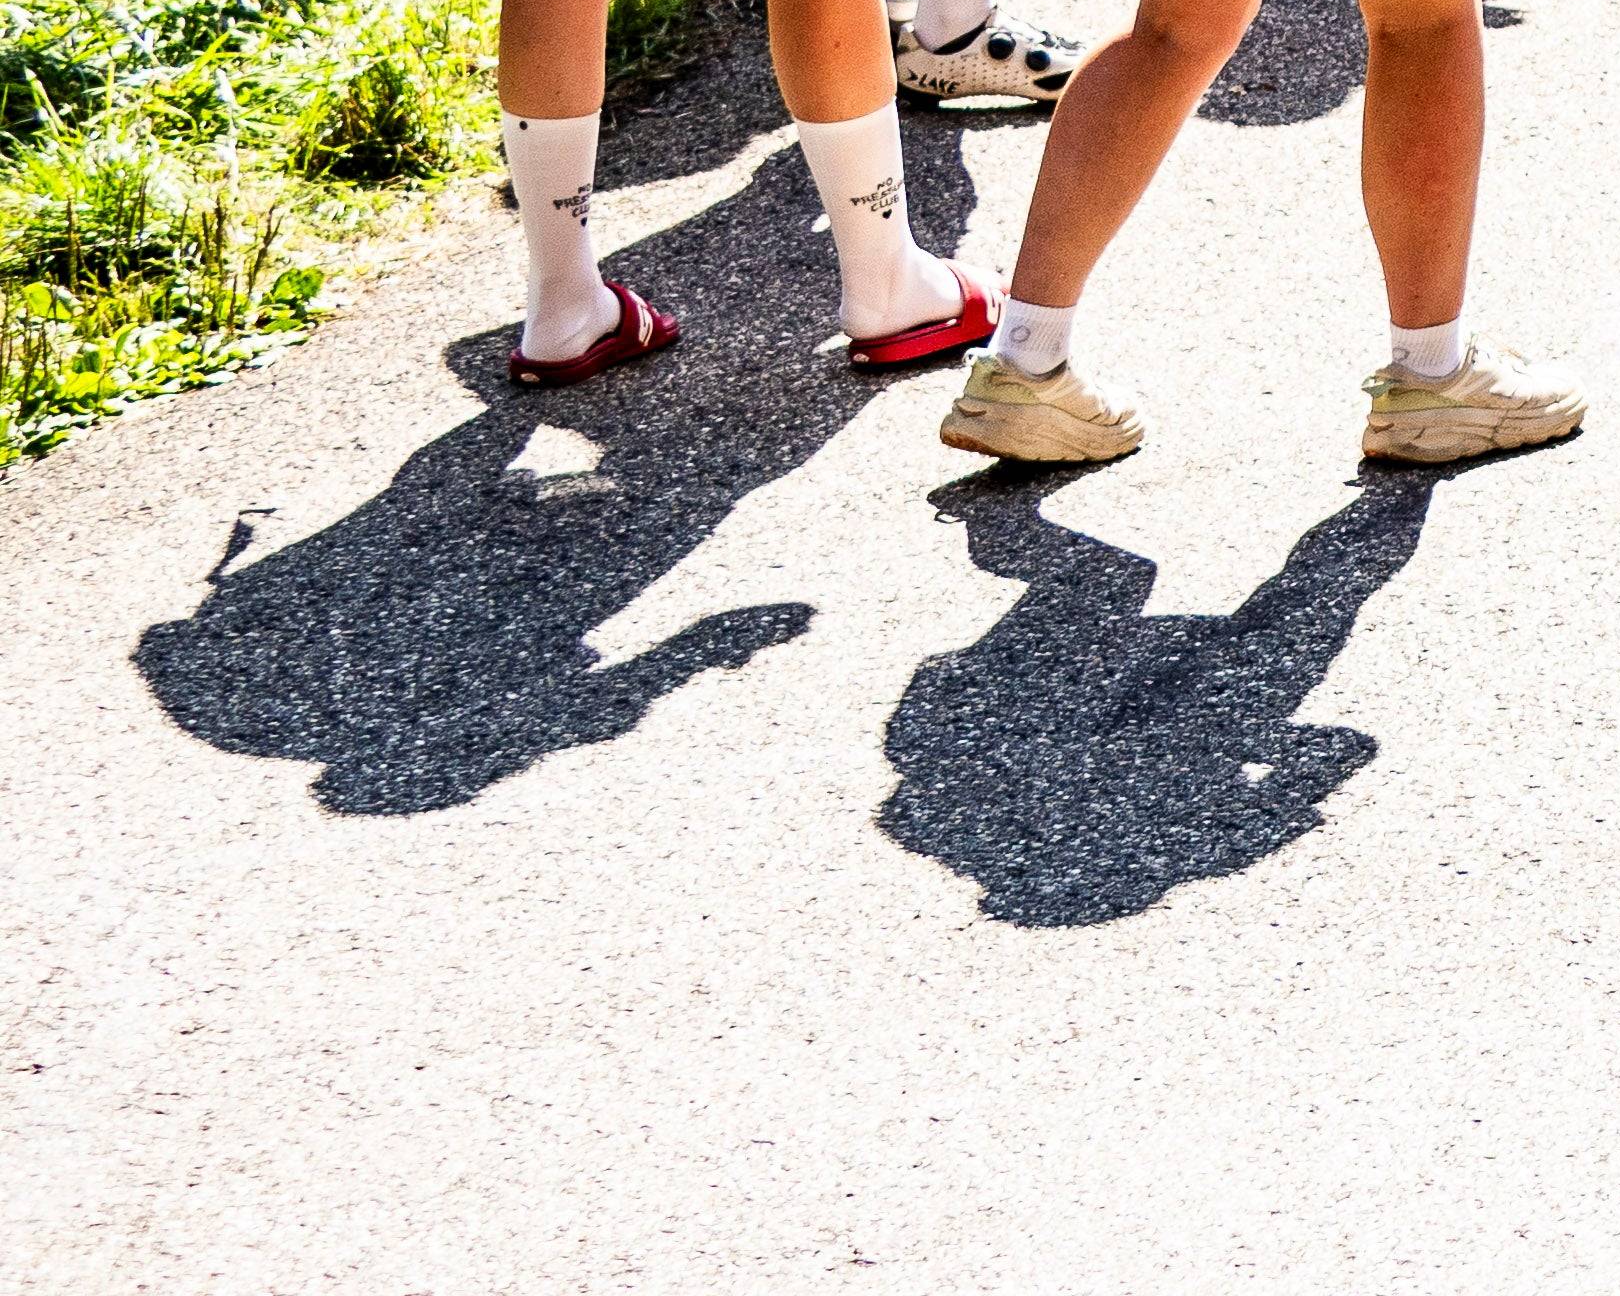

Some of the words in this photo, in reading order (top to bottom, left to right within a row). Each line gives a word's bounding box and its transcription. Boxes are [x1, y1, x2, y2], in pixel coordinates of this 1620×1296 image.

[918, 72, 961, 96] LAKE
[876, 176, 894, 192] NO
[870, 194, 900, 214] CLUB
